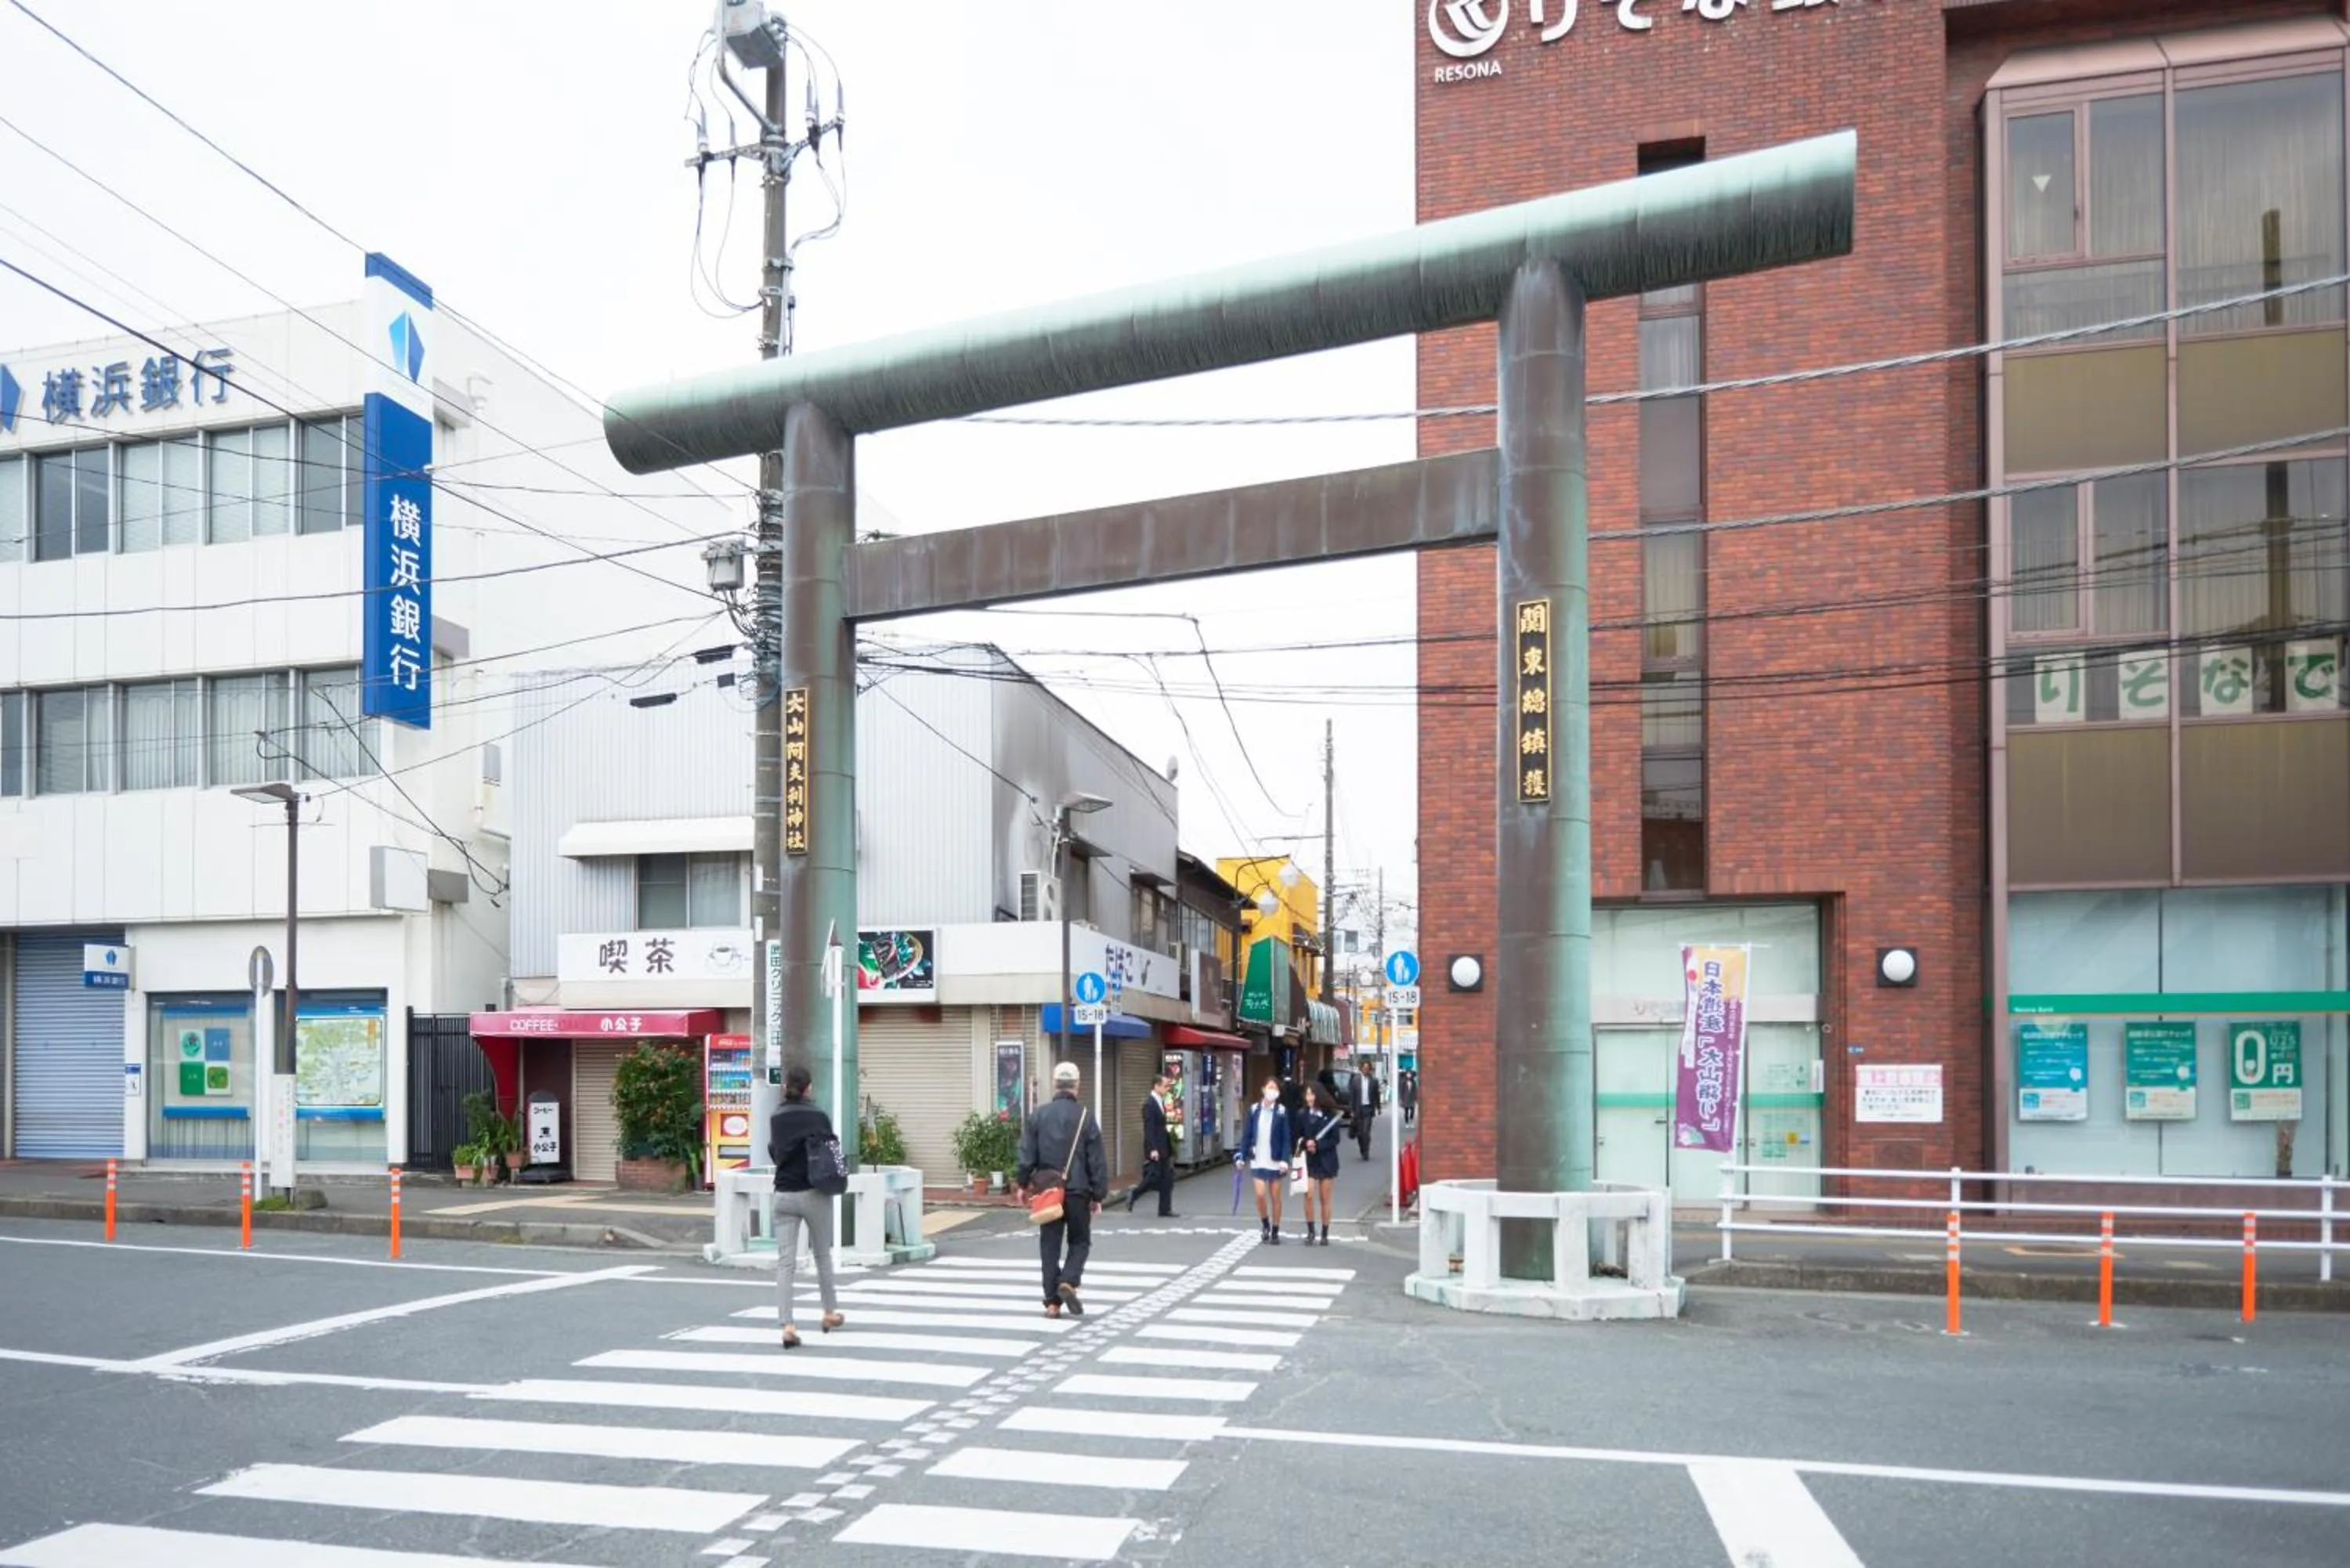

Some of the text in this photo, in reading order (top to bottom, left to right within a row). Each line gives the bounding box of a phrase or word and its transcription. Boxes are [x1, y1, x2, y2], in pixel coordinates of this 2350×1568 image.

[1434, 60, 1502, 83] RESONA
[42, 347, 235, 424] 横浜銀行
[389, 493, 422, 692] 横浜銀行
[786, 692, 805, 850] 大山阿夫利神社
[599, 938, 676, 974] 喫茶
[1105, 942, 1133, 983] たばこ
[1389, 991, 1417, 1003] 15-18
[600, 1017, 643, 1032] 小公子
